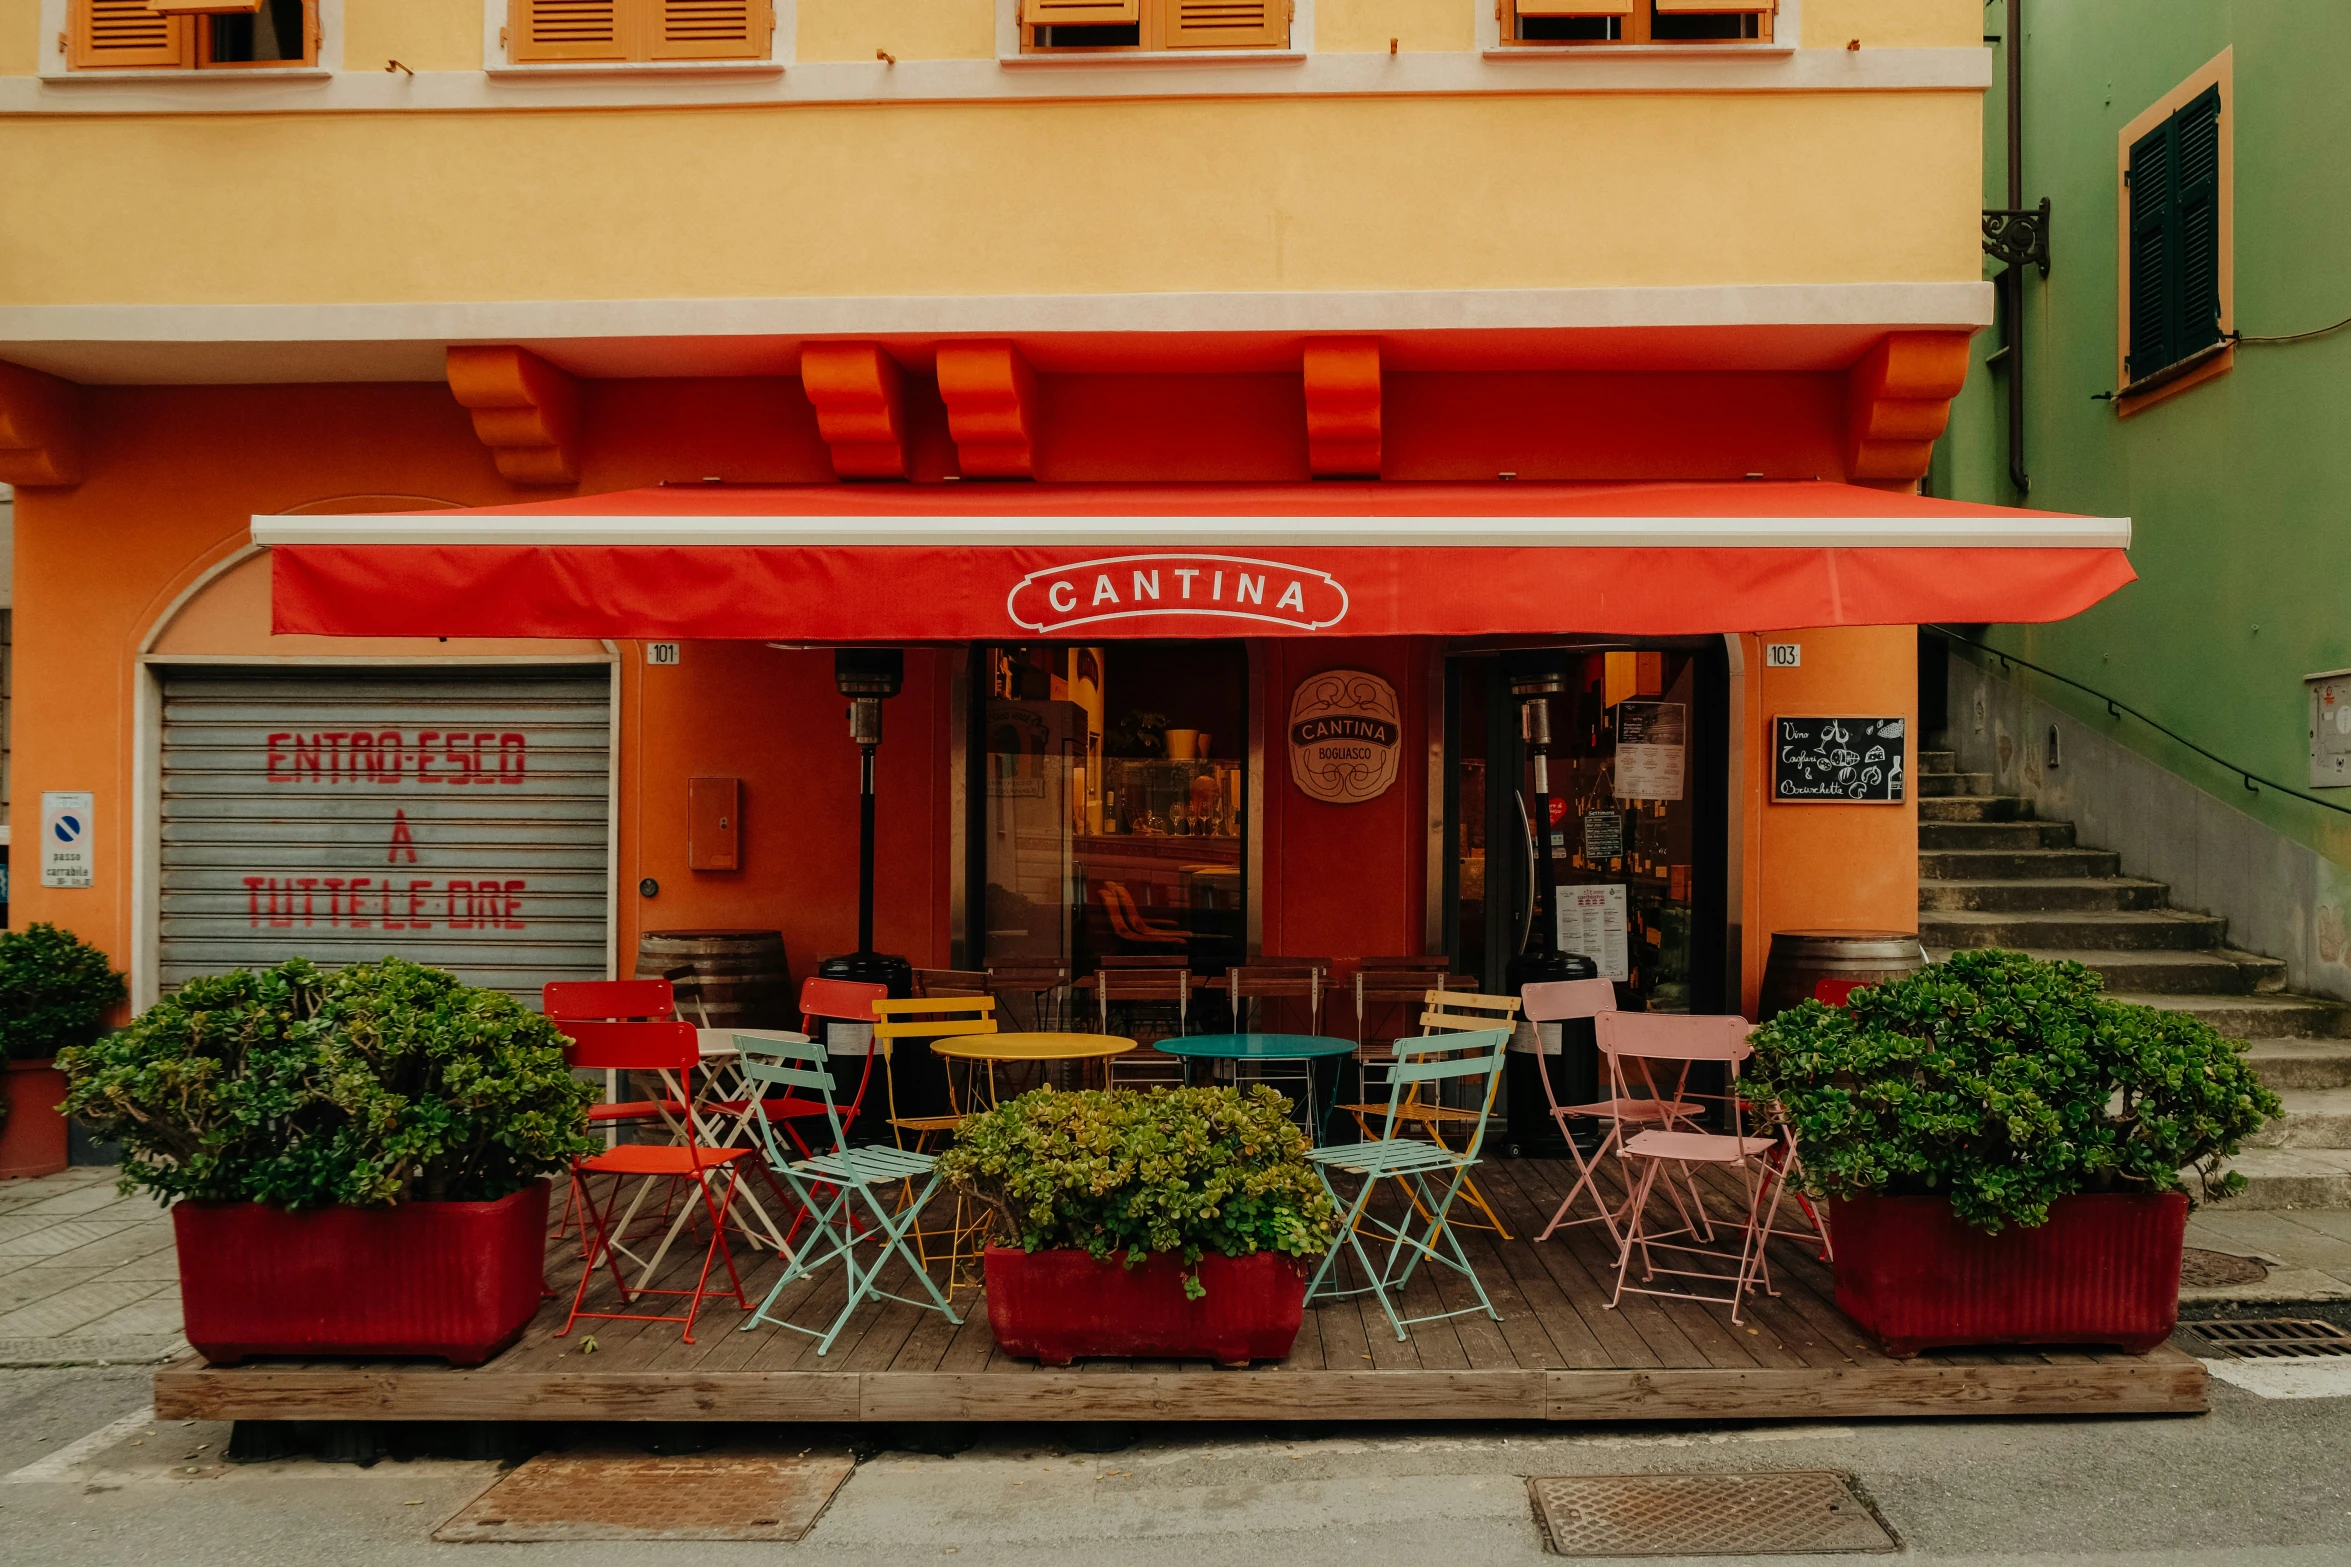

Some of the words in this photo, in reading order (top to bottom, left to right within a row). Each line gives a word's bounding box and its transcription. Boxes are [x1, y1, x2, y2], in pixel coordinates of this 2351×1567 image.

[1048, 569, 1305, 613] CANTINA
[653, 644, 674, 663] 101
[1771, 645, 1796, 665] 103
[1301, 720, 1386, 742] CANTINA
[1782, 721, 1810, 741] Vino
[1318, 747, 1372, 760] BOGLIASCO
[1781, 745, 1817, 770] Taglieri
[1804, 766, 1813, 780] &
[1780, 779, 1844, 796] Bruschette
[387, 808, 418, 863] A
[53, 853, 82, 864] passo
[46, 866, 89, 877] carrabile
